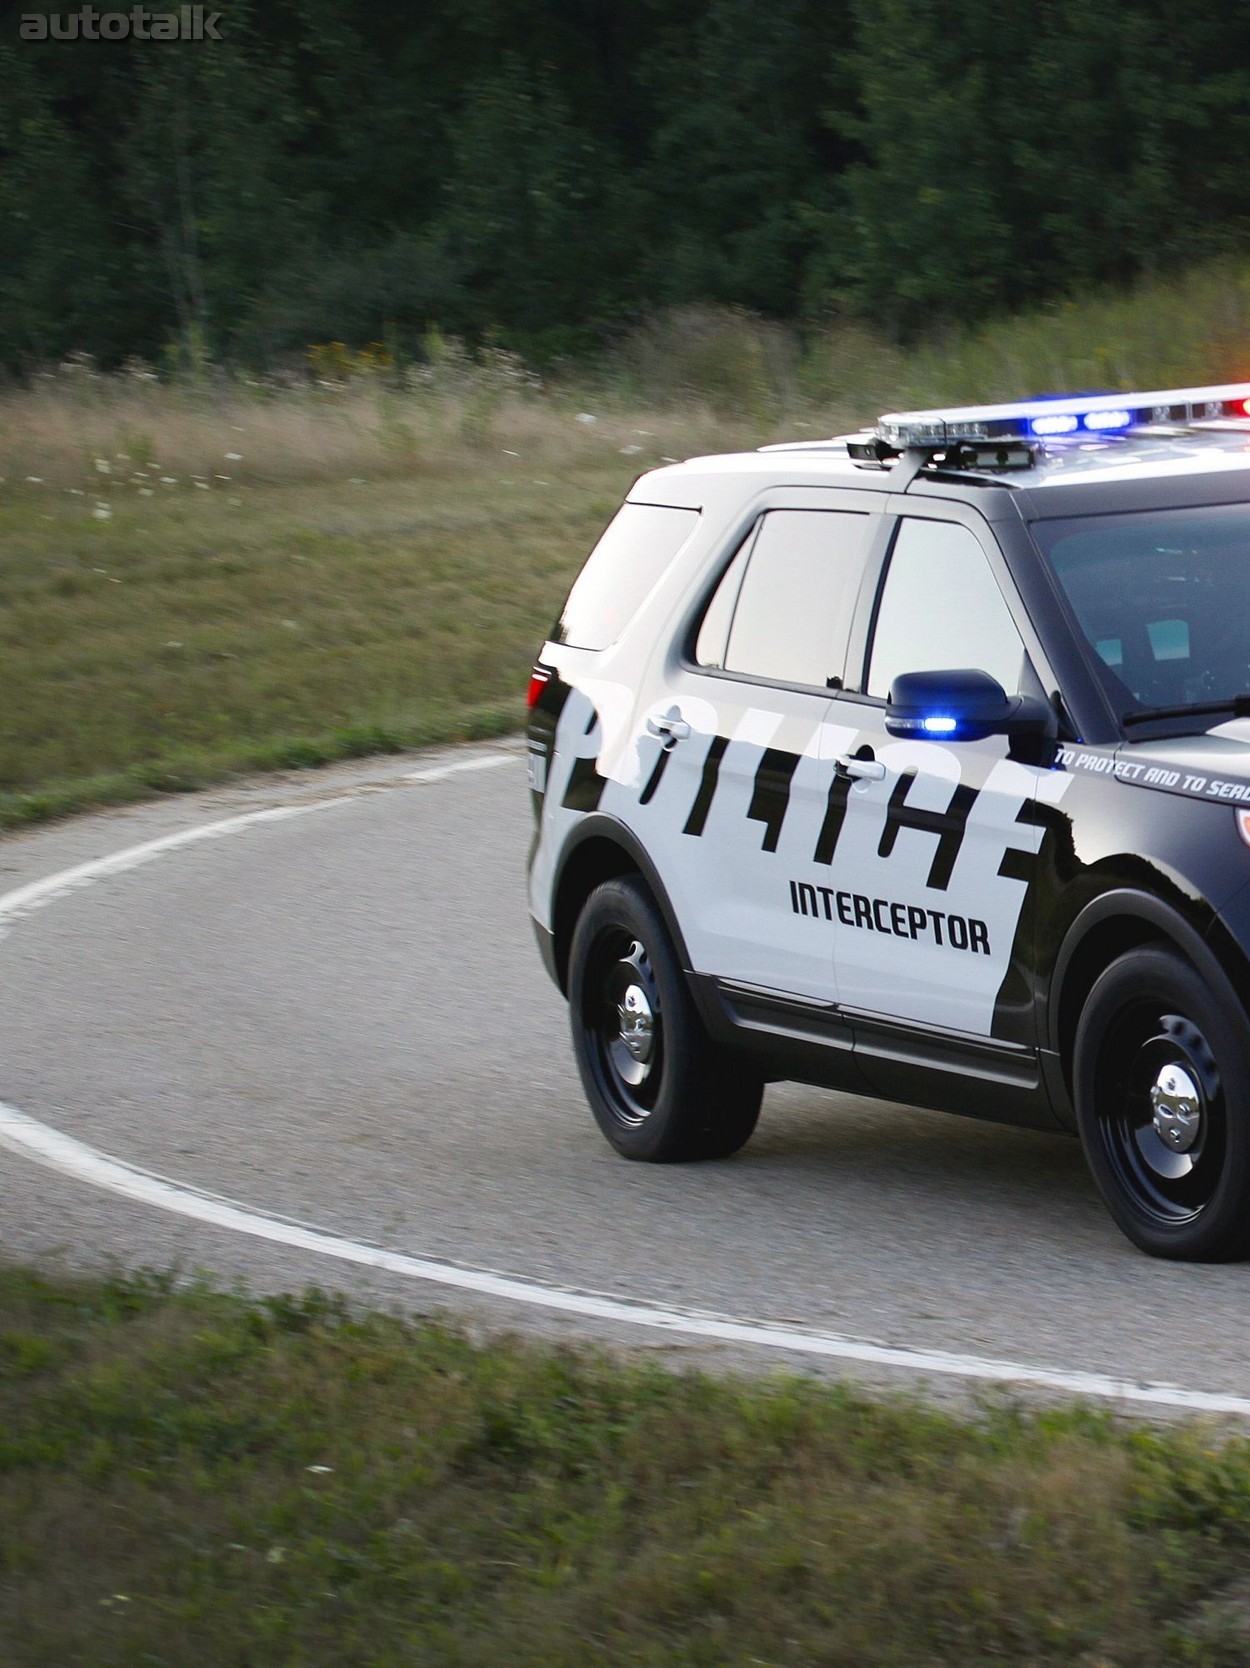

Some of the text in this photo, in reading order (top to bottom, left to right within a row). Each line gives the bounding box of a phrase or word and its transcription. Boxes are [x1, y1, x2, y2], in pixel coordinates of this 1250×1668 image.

[543, 677, 1075, 892] POLICE
[1054, 749, 1075, 765] TO
[1075, 753, 1146, 780] PROTECT
[1144, 767, 1182, 787] AND
[1183, 775, 1207, 792] TO
[789, 880, 991, 956] INTERCEPTOR
